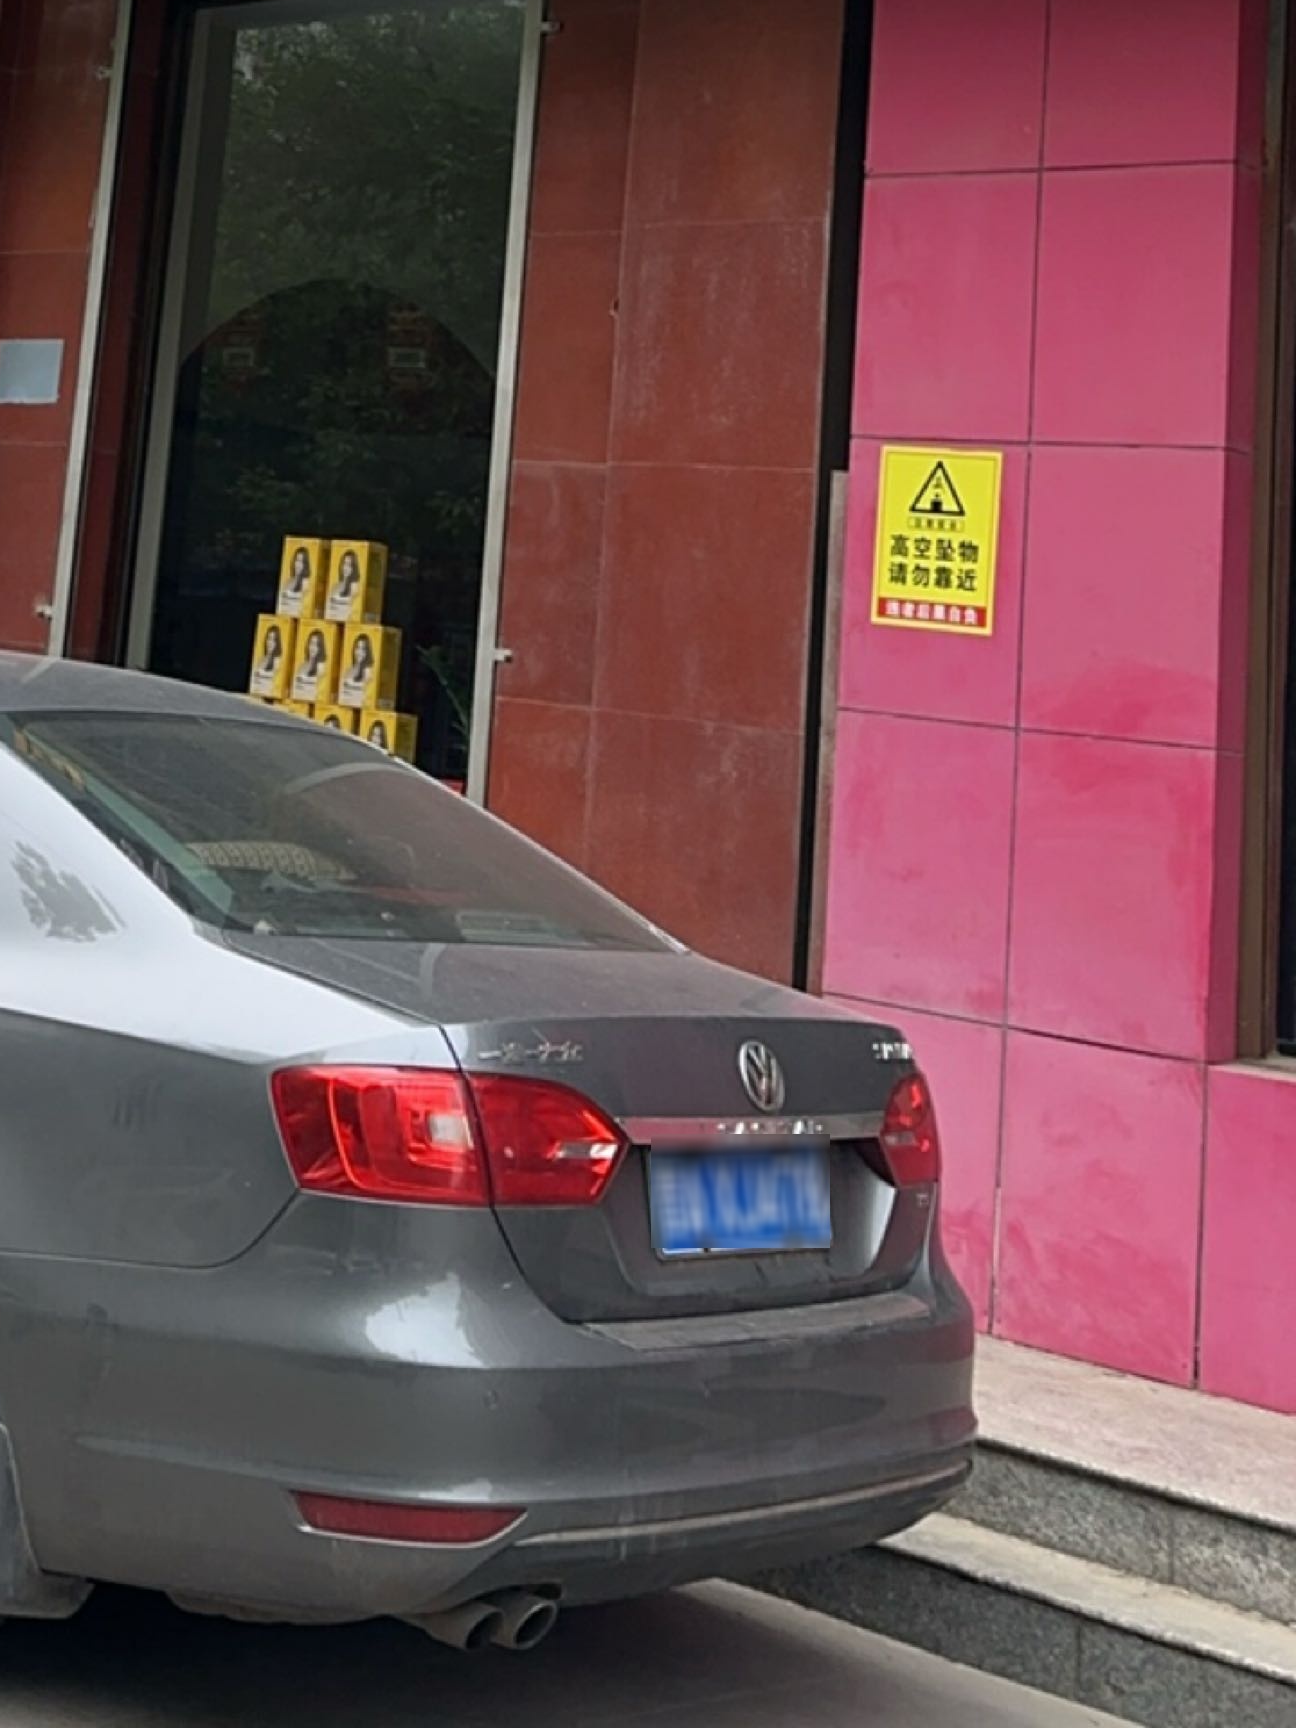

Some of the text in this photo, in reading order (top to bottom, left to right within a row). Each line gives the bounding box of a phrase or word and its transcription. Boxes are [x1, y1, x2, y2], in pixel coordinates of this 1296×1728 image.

[890, 534, 979, 564] 高空坠物
[888, 563, 978, 592] 请勿靠近
